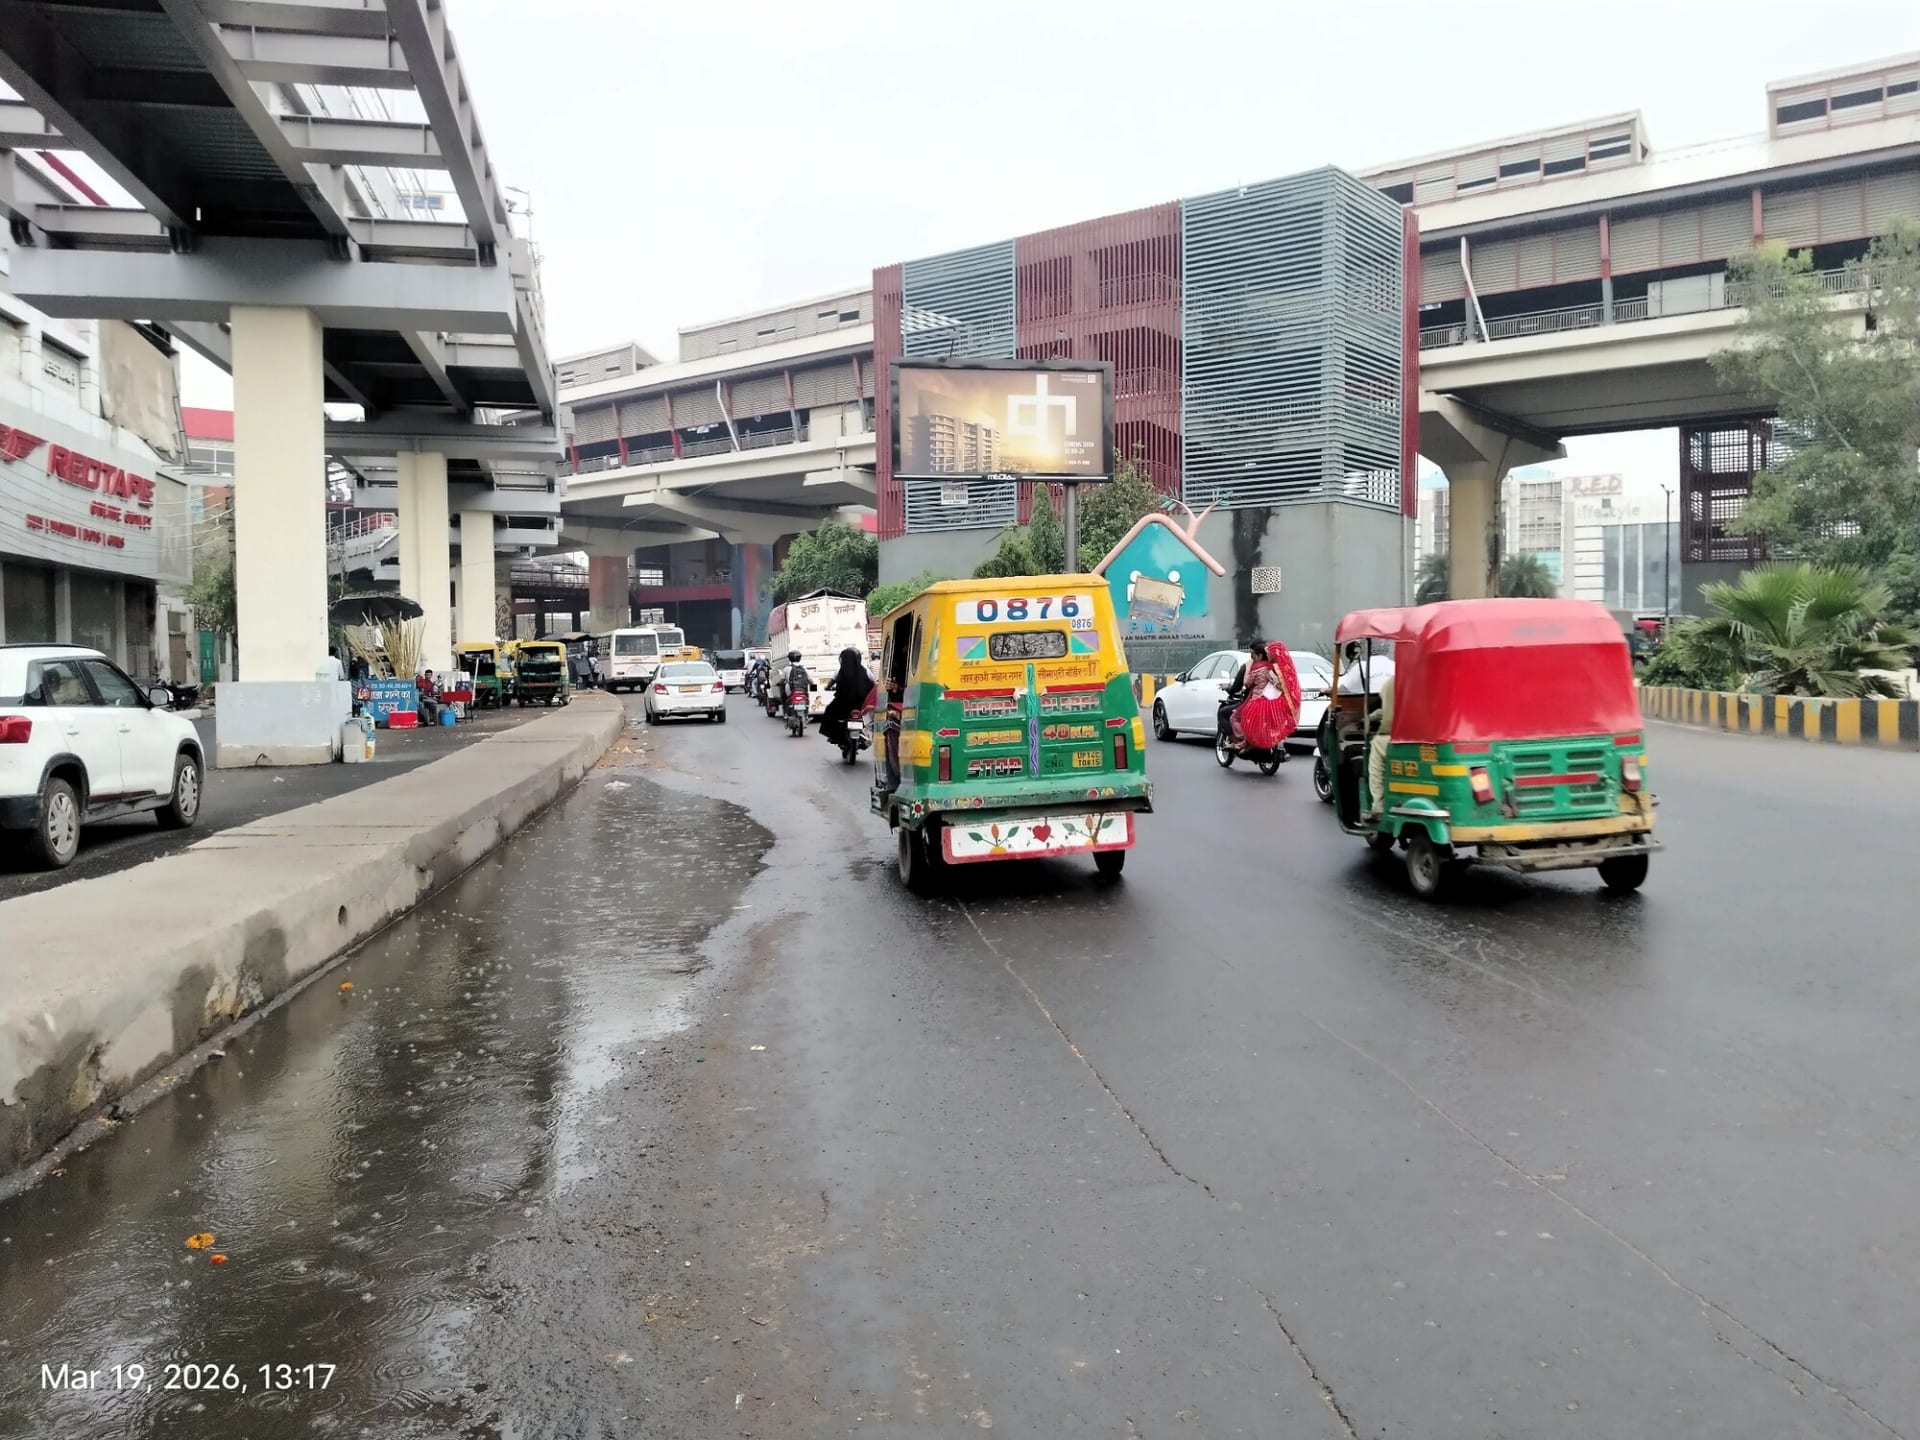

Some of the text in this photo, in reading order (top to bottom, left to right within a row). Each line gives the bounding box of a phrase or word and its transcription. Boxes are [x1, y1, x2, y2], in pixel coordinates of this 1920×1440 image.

[976, 595, 1079, 621] 0876
[1071, 618, 1092, 629] 0876
[963, 699, 1018, 718] HORN
[966, 730, 1022, 746] SPEED
[967, 757, 1023, 778] STOP
[1045, 759, 1064, 768] CNG
